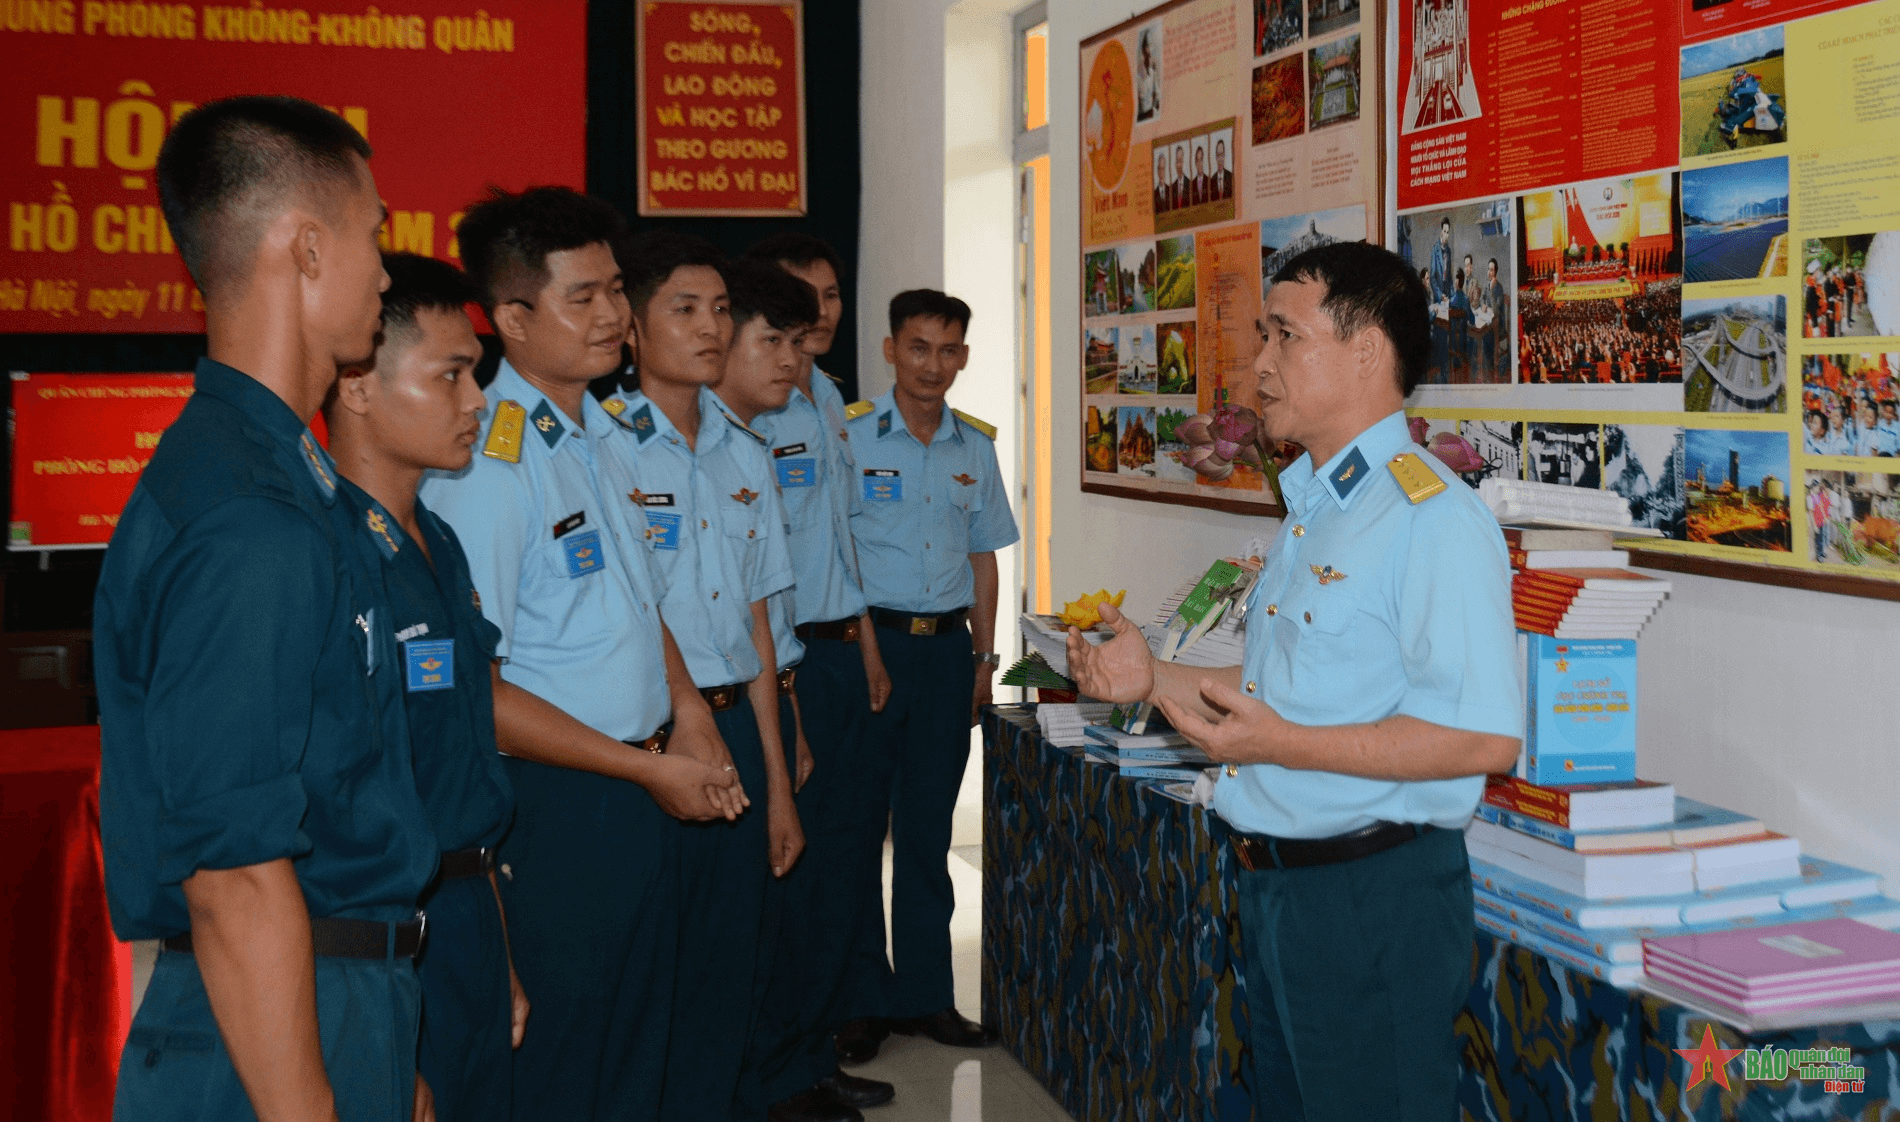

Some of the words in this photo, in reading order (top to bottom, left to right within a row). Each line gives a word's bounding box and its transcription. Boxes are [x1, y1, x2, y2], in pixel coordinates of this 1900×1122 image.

[433, 9, 515, 54] QUÂN
[689, 6, 761, 37] SỐNG,
[664, 37, 727, 64] CHIẾN
[731, 40, 783, 69] ĐẤU,
[663, 73, 706, 95] LAO
[712, 71, 777, 100] ĐỘNG
[655, 101, 686, 127] VÀ
[690, 106, 739, 131] HỌC
[745, 103, 782, 131] TẬP
[655, 138, 707, 160] THEO
[710, 138, 788, 160] GƯƠNG
[651, 166, 695, 191] BÁC
[697, 163, 730, 191] HỒ
[734, 167, 755, 191] VĨ
[760, 169, 796, 194] ĐẠI
[10, 180, 79, 253] HỒ
[88, 280, 152, 320] ngày
[157, 280, 186, 312] 11
[34, 455, 106, 475] PHÒNG
